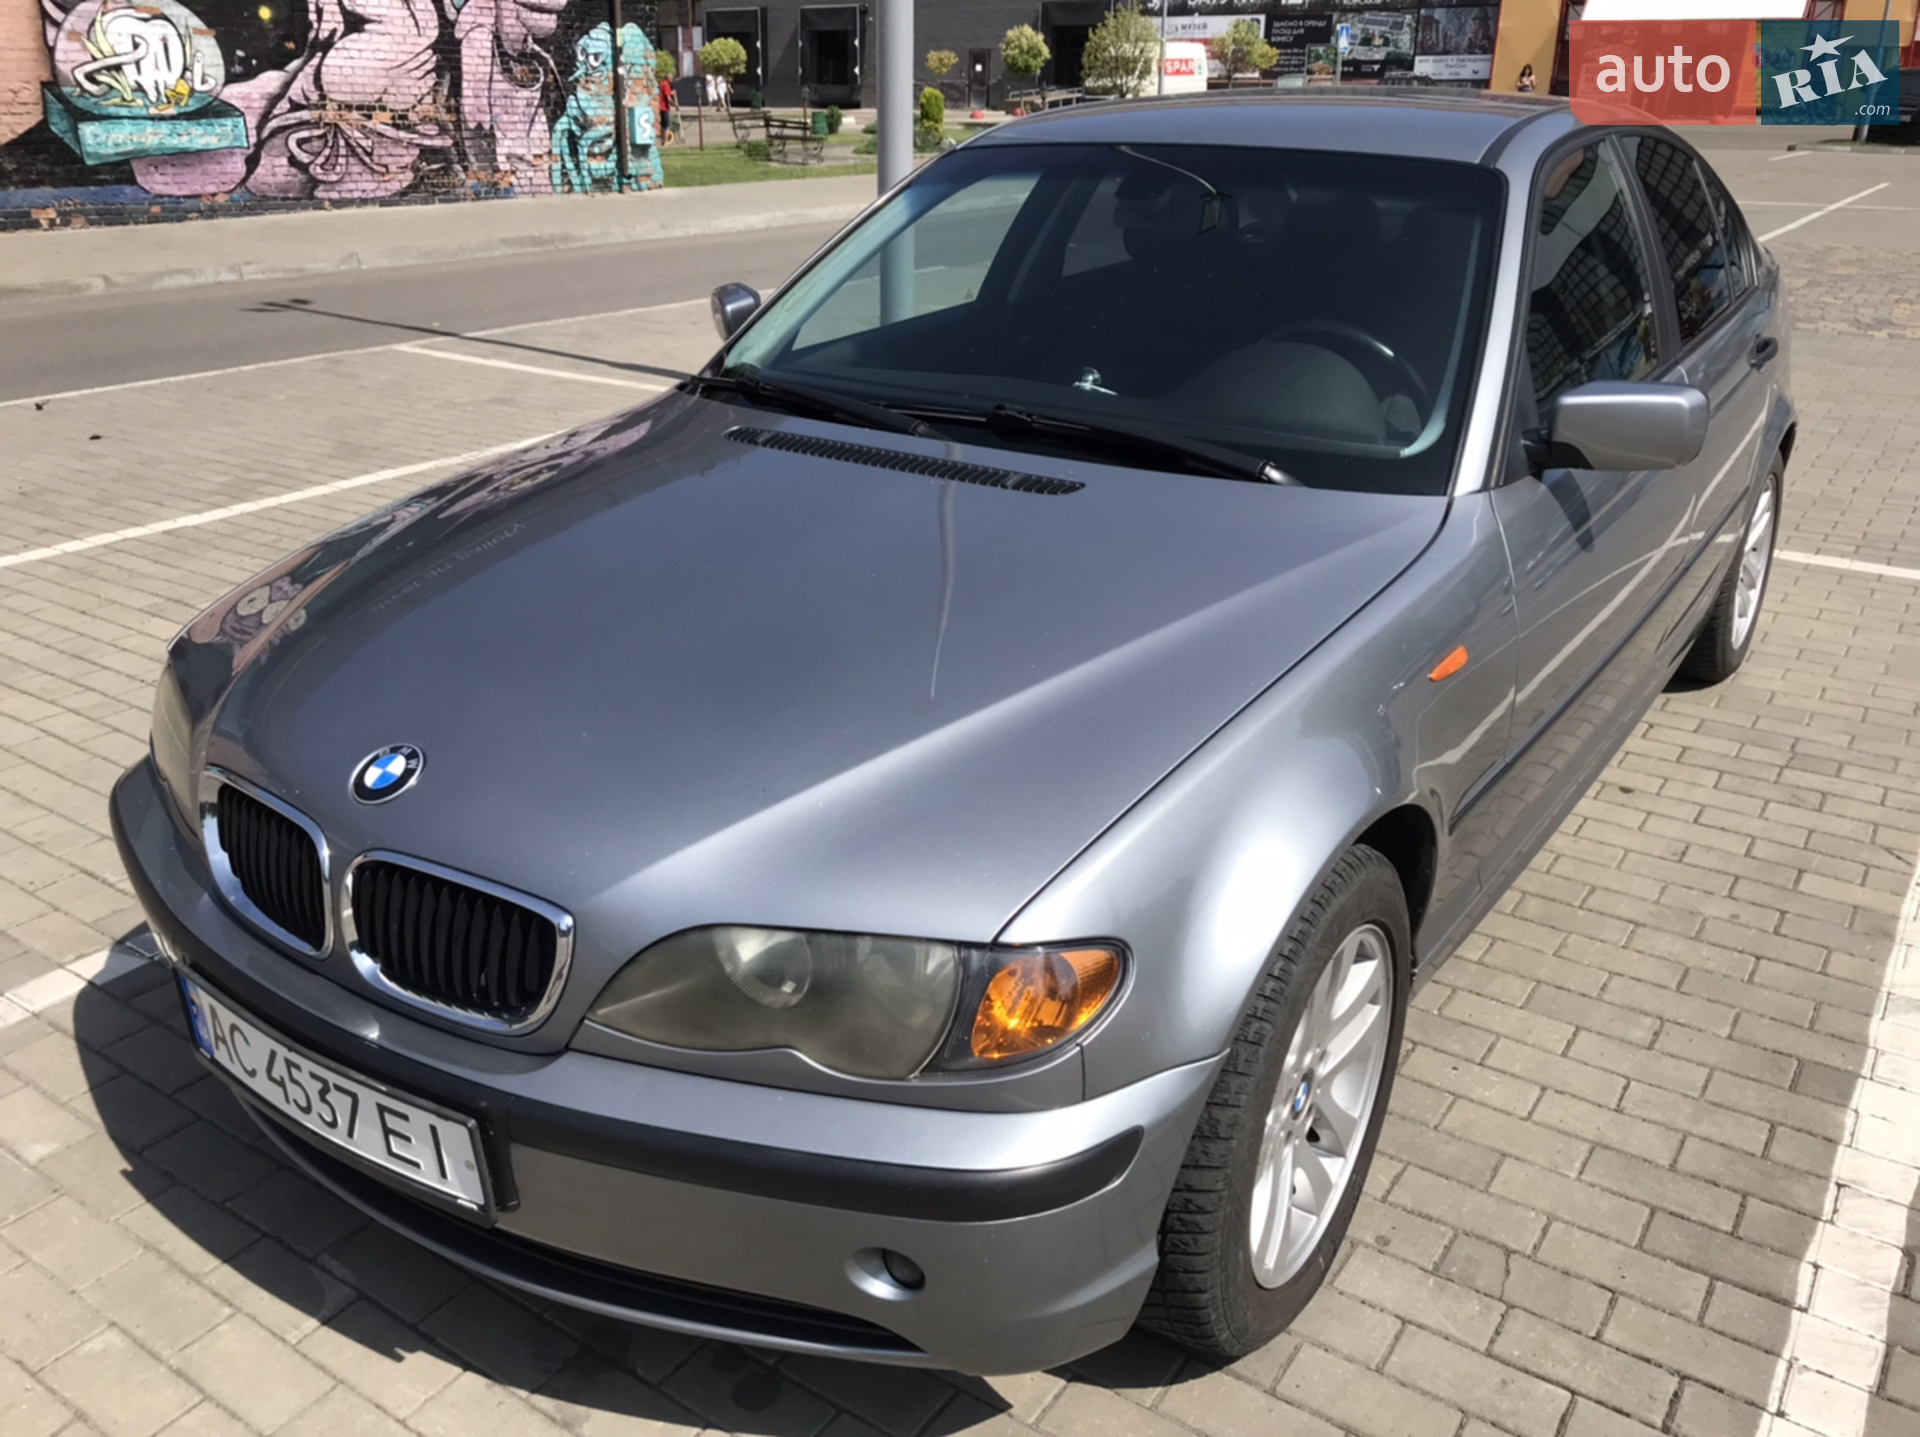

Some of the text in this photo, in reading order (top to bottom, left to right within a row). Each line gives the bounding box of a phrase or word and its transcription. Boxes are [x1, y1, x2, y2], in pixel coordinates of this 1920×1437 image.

[1181, 21, 1208, 31] МУЗЕЙ
[1164, 59, 1194, 73] SPAR
[209, 1002, 450, 1181] AC 4537 EI
